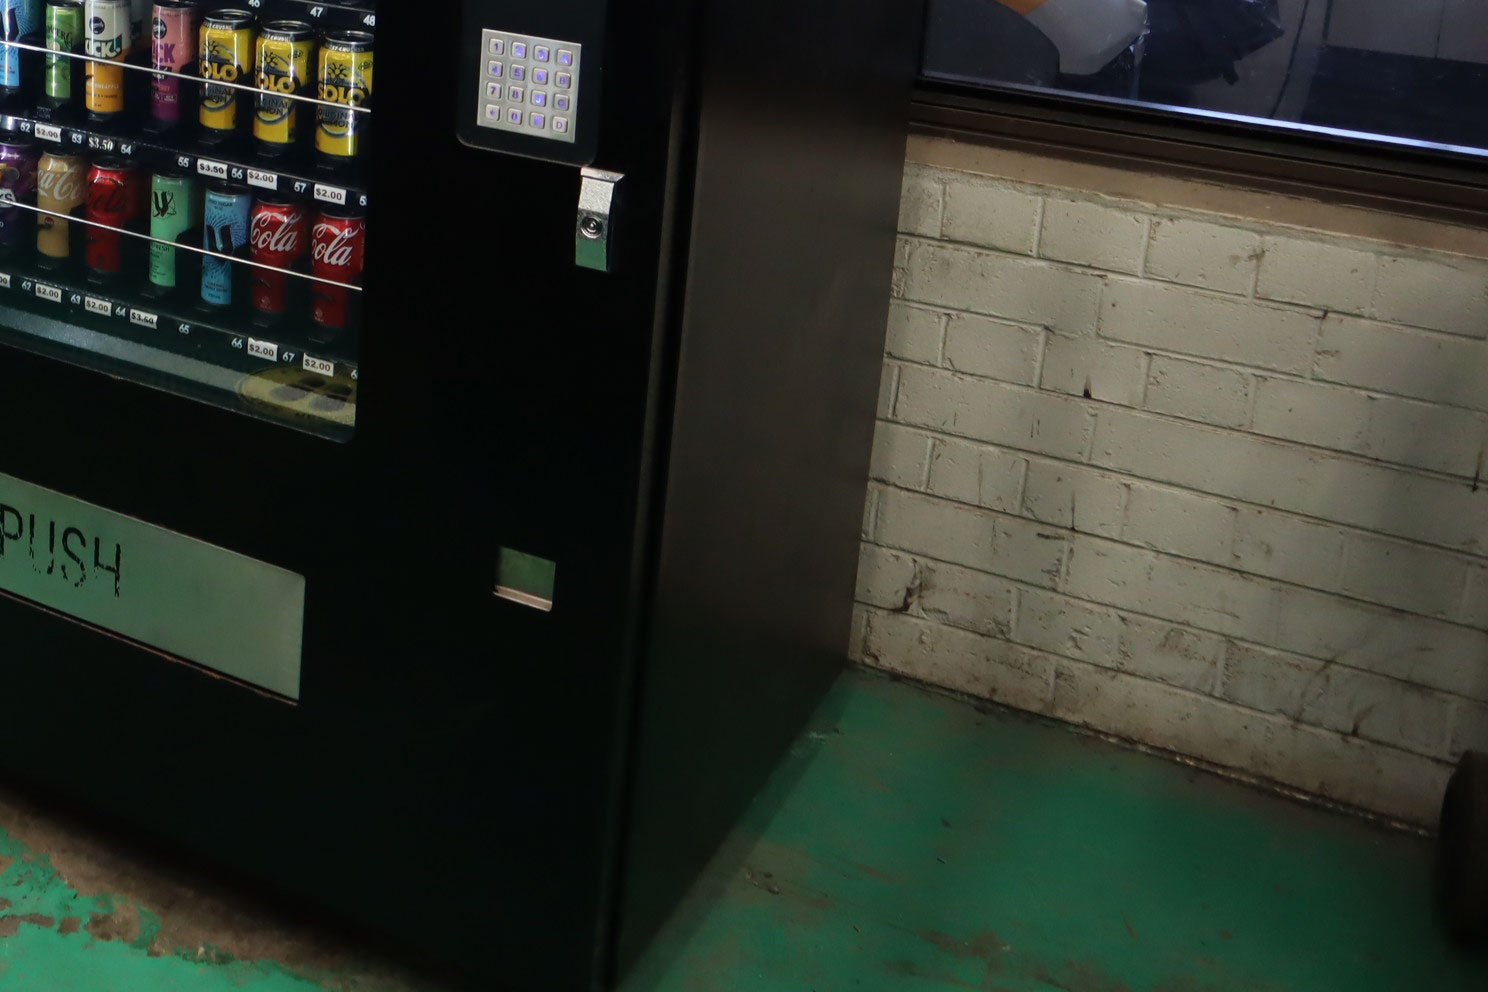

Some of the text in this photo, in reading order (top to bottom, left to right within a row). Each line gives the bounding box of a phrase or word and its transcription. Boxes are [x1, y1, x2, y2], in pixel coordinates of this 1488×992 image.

[311, 6, 323, 17] 47
[364, 14, 375, 26] 48
[494, 42, 498, 51] 1
[318, 84, 366, 105] SOLO
[491, 86, 496, 94] 7
[557, 121, 563, 129] D
[21, 123, 31, 133] 52
[36, 128, 58, 138] $2.00
[72, 133, 82, 144] 53
[89, 137, 114, 151] $3.50
[121, 145, 131, 155] 54
[178, 157, 342, 200] 55 $3.50 56 $2.00 57 $2.00
[22, 280, 31, 291] 62
[37, 287, 59, 299] $2.00
[71, 294, 81, 305] 63
[86, 300, 108, 312] $2.00
[115, 306, 126, 317] 64
[178, 324, 331, 372] 65 66 $2.00 67 $2.00
